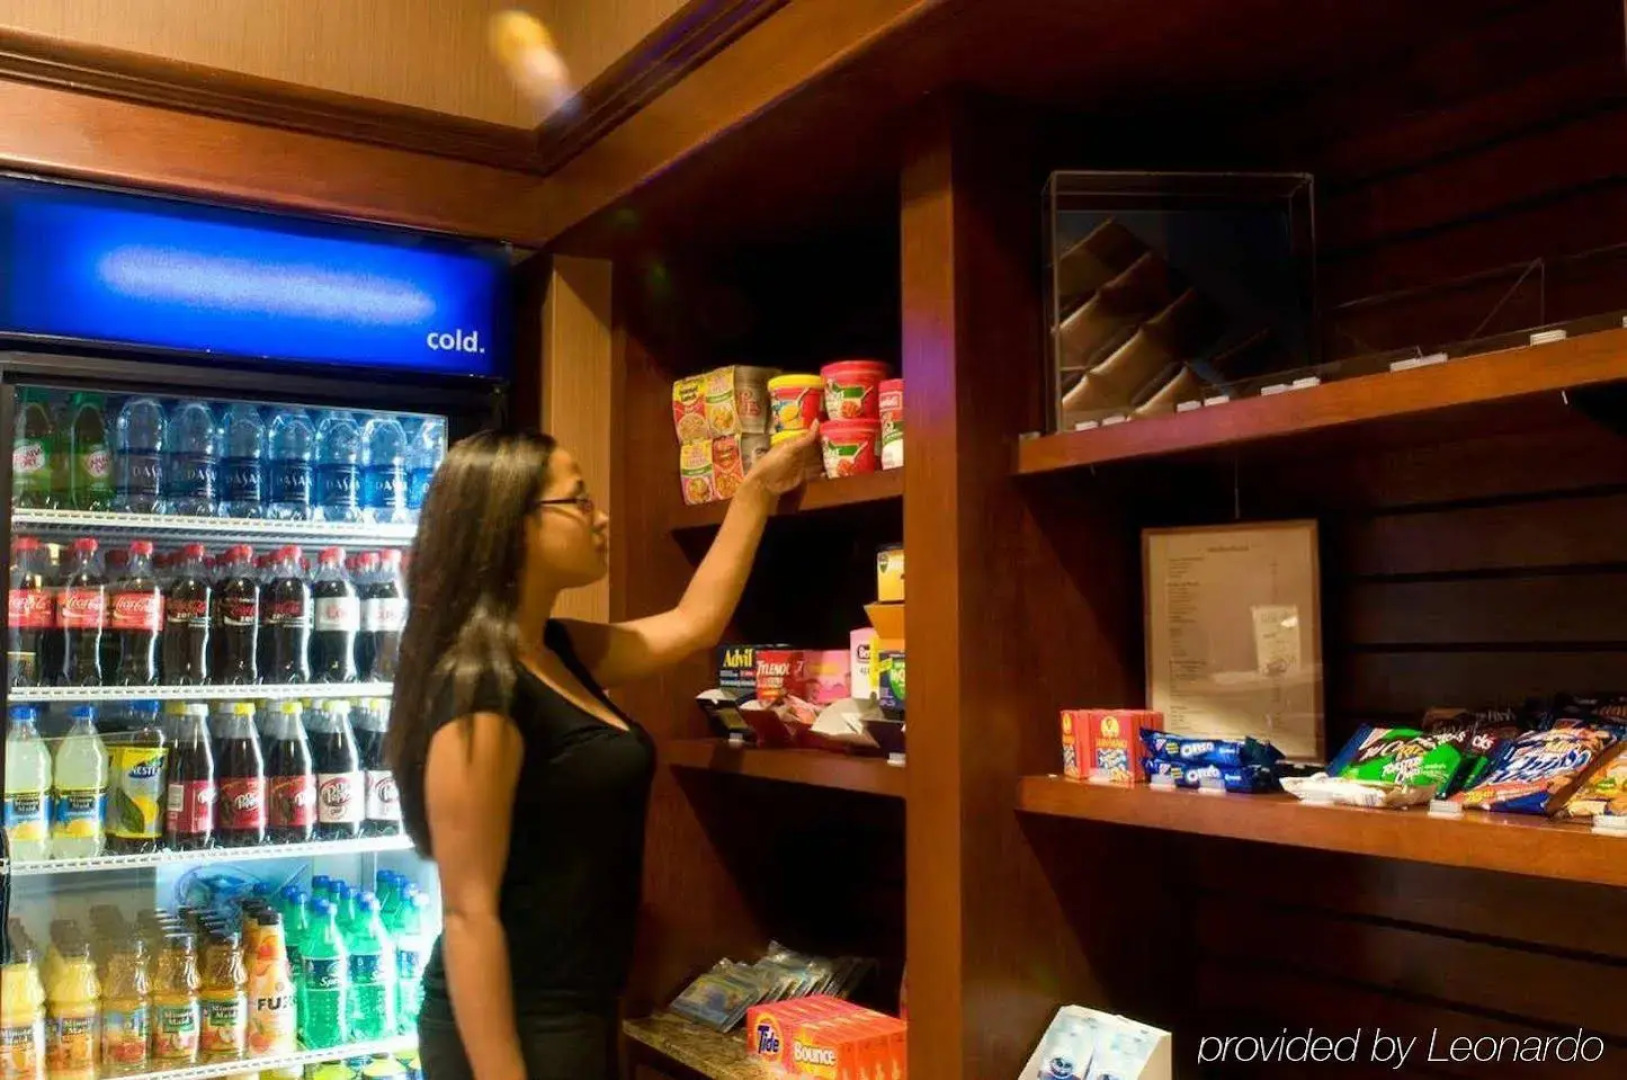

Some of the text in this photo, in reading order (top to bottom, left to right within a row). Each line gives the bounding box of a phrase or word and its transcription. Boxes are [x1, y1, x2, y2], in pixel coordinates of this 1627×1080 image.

[426, 328, 485, 354] cold.
[723, 648, 754, 668] Advil
[756, 1025, 781, 1054] Tide
[793, 1041, 837, 1066] Bounce
